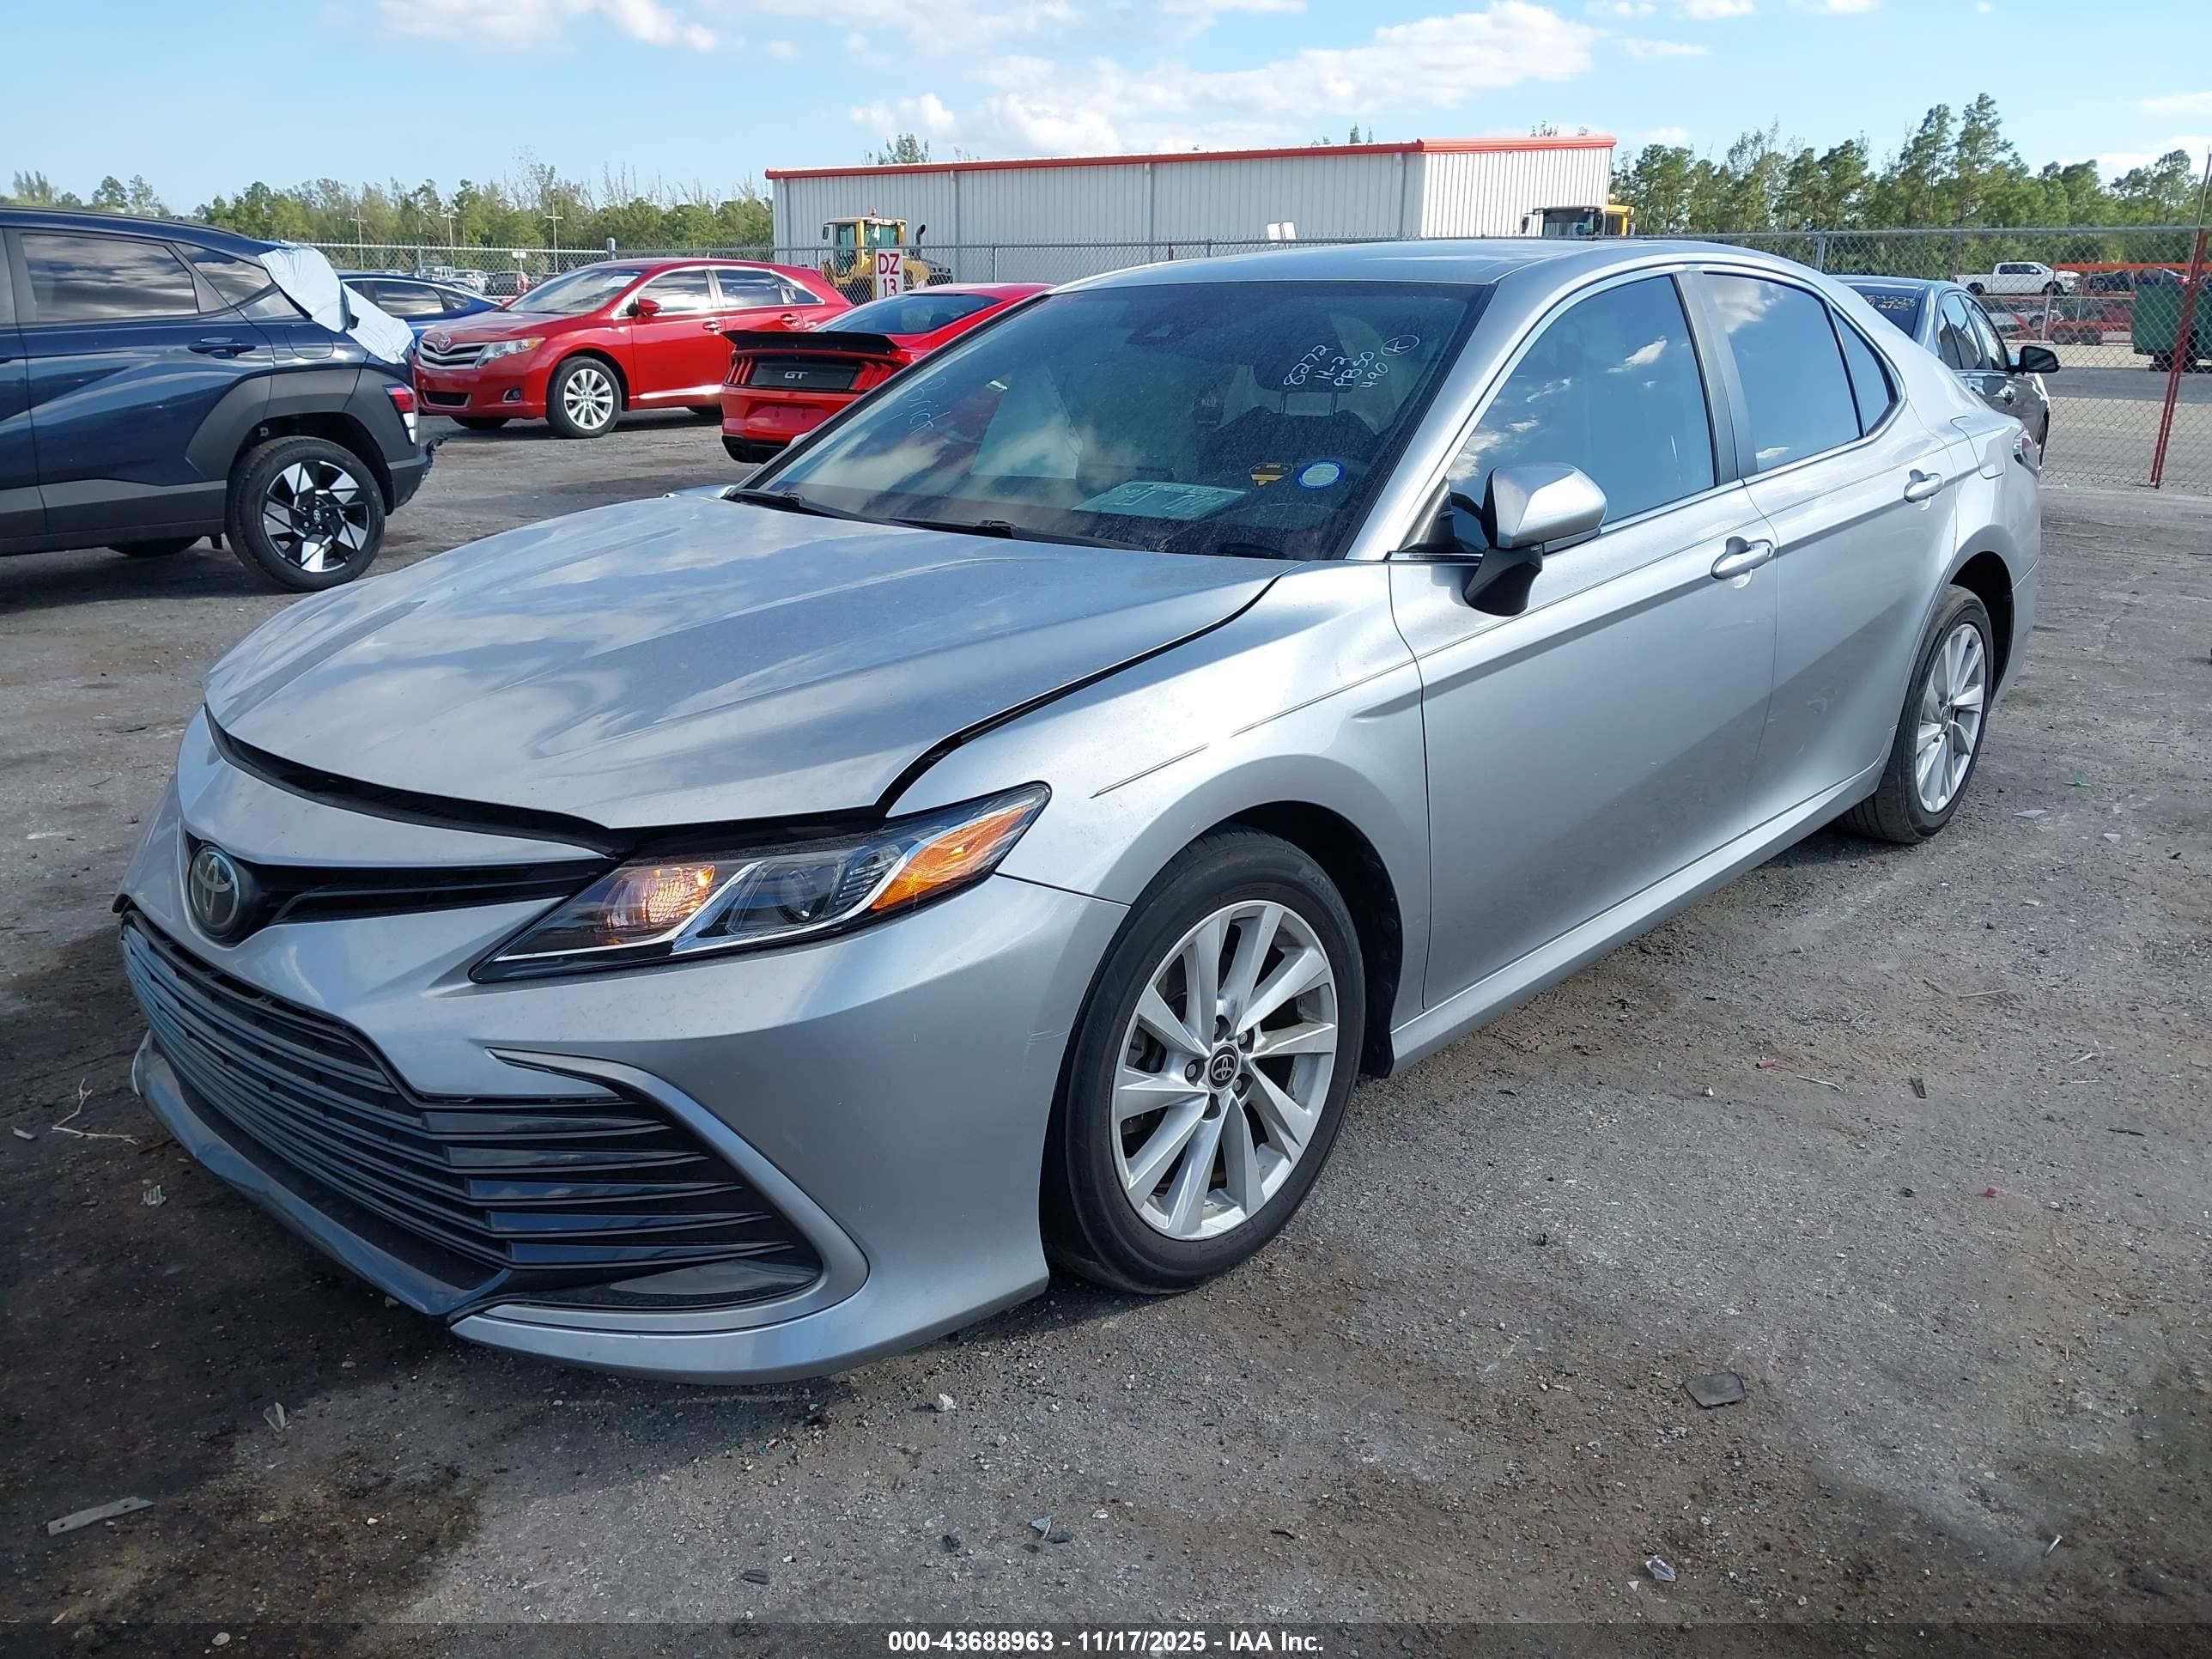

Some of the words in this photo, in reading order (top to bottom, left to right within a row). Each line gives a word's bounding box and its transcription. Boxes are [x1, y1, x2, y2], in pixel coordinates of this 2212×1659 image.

[878, 252, 900, 275] DZ
[883, 277, 897, 297] 13
[784, 371, 809, 380] GT
[1284, 344, 1335, 386] 8272
[1359, 362, 1389, 388] 490
